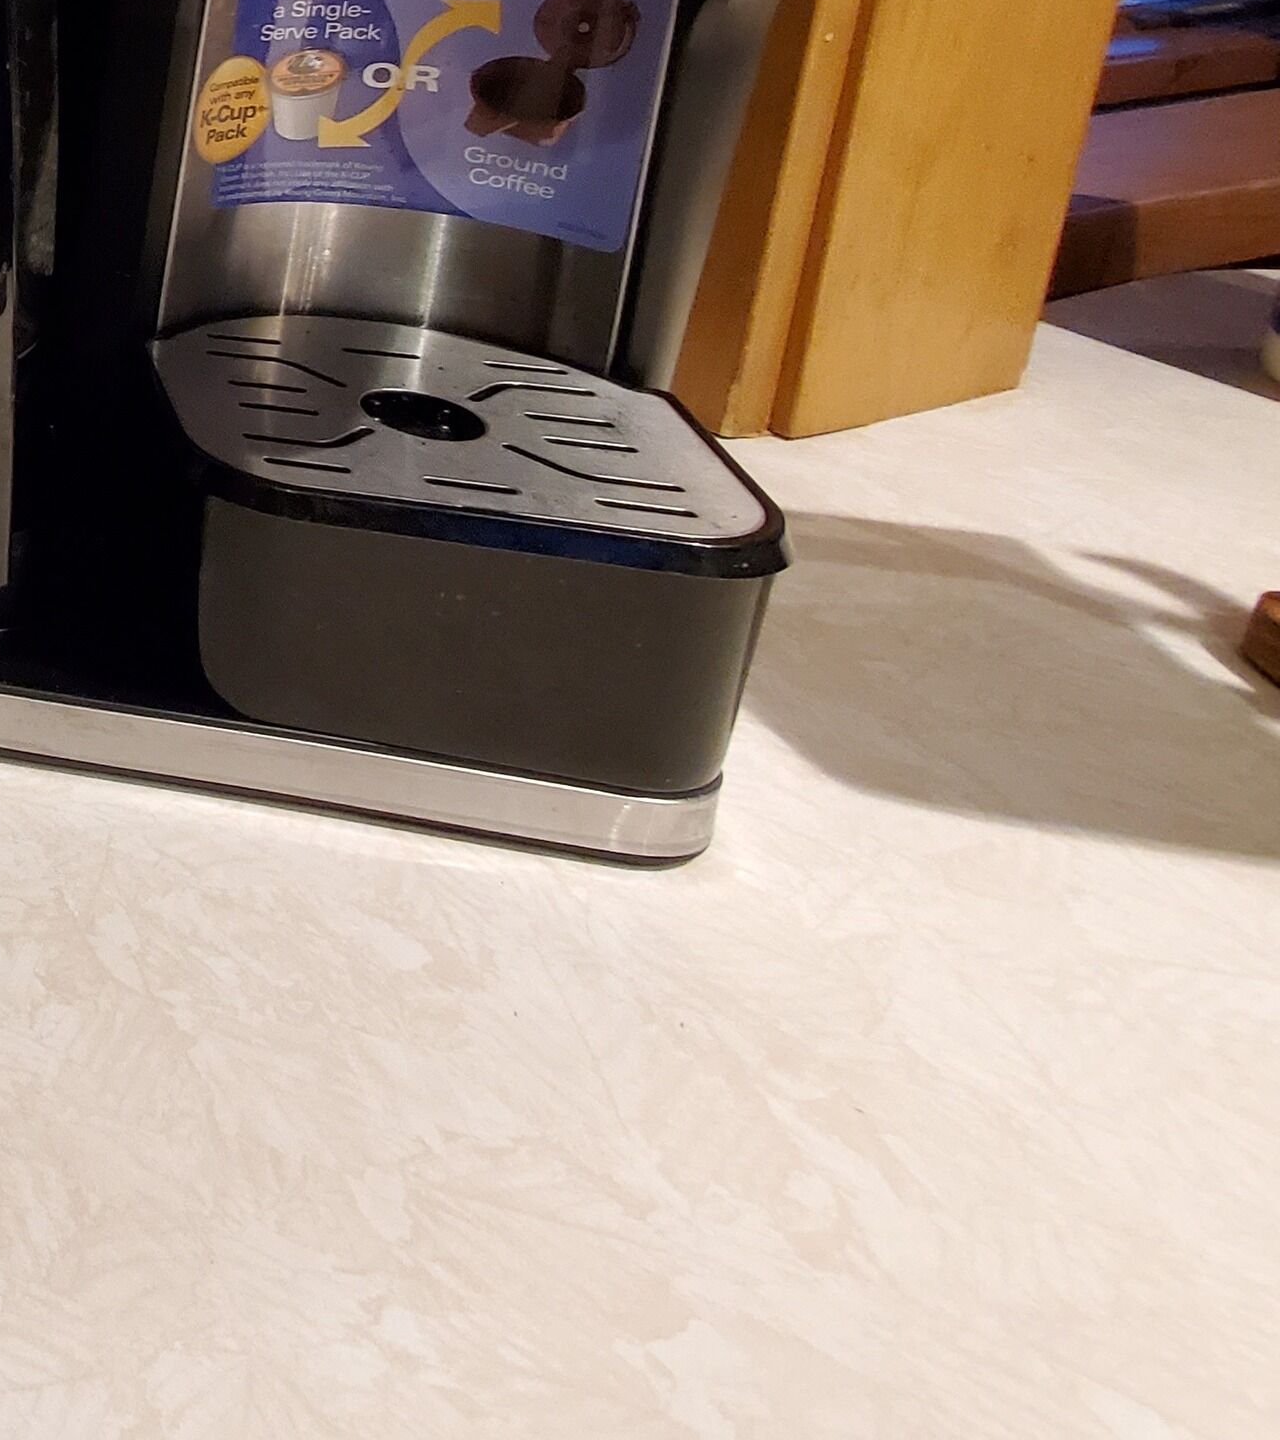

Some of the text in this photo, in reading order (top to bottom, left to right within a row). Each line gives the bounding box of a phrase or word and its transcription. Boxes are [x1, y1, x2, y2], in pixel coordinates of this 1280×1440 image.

[273, 0, 371, 22] a Single-
[260, 22, 382, 43] Serve Pack
[362, 62, 440, 93] OR
[206, 123, 248, 146] Pack
[463, 145, 568, 181] Ground
[468, 166, 555, 201] Coffee
